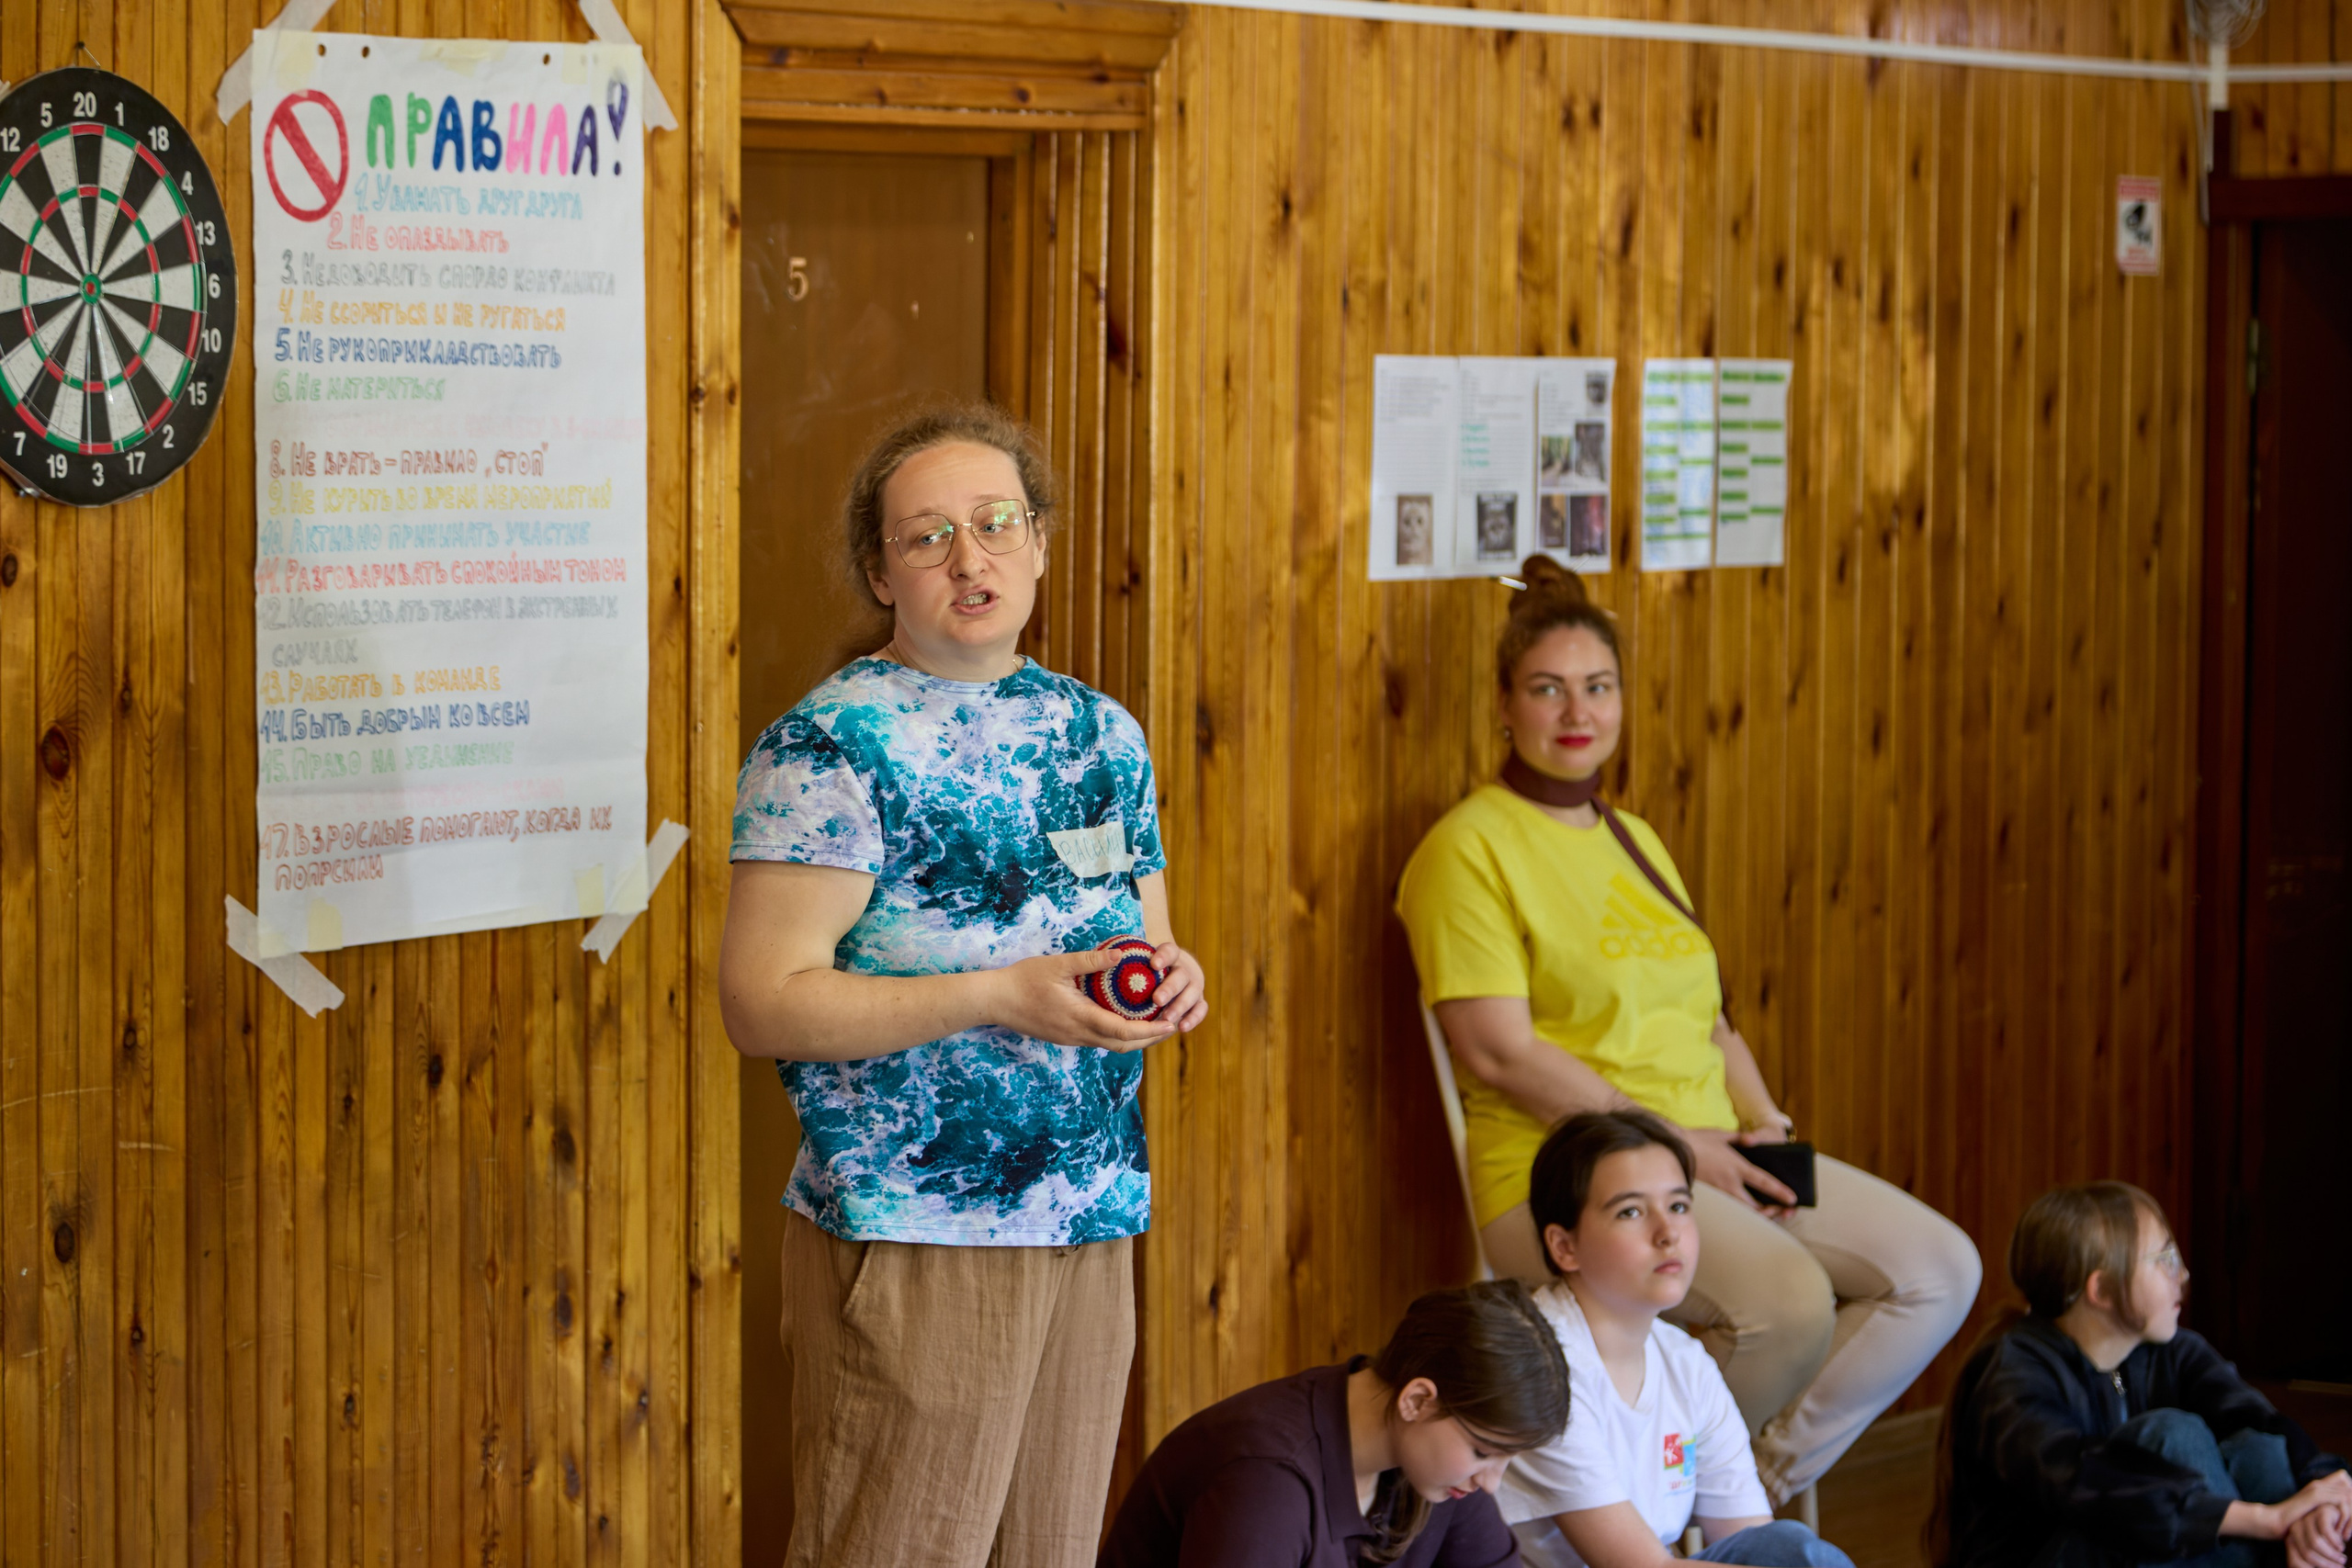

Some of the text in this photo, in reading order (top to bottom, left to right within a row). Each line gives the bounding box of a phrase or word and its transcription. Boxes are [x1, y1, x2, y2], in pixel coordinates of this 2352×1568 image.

[40, 103, 53, 128] 5
[74, 92, 97, 117] 20
[115, 104, 124, 125] 1
[368, 73, 629, 176] ПРАВИЛА!
[1, 128, 20, 152] 12
[149, 127, 169, 151] 18
[181, 171, 194, 195] 4
[197, 221, 216, 245] 13
[386, 225, 510, 254] ОПАЗДЫВАТЬ
[208, 275, 221, 299] 6
[788, 257, 808, 301] 5
[330, 299, 427, 326] ССОРИТЬСЯ
[435, 302, 447, 326] И
[453, 302, 474, 327] НЕ
[480, 303, 566, 333] РУГАТЬСЯ
[202, 329, 221, 353] 10
[188, 382, 208, 406] 15
[14, 432, 27, 457] 7
[163, 424, 175, 448] 2
[47, 454, 68, 479] 19
[93, 463, 105, 487] 3
[126, 452, 146, 475] 17
[414, 665, 502, 694] КОМАНДЕ
